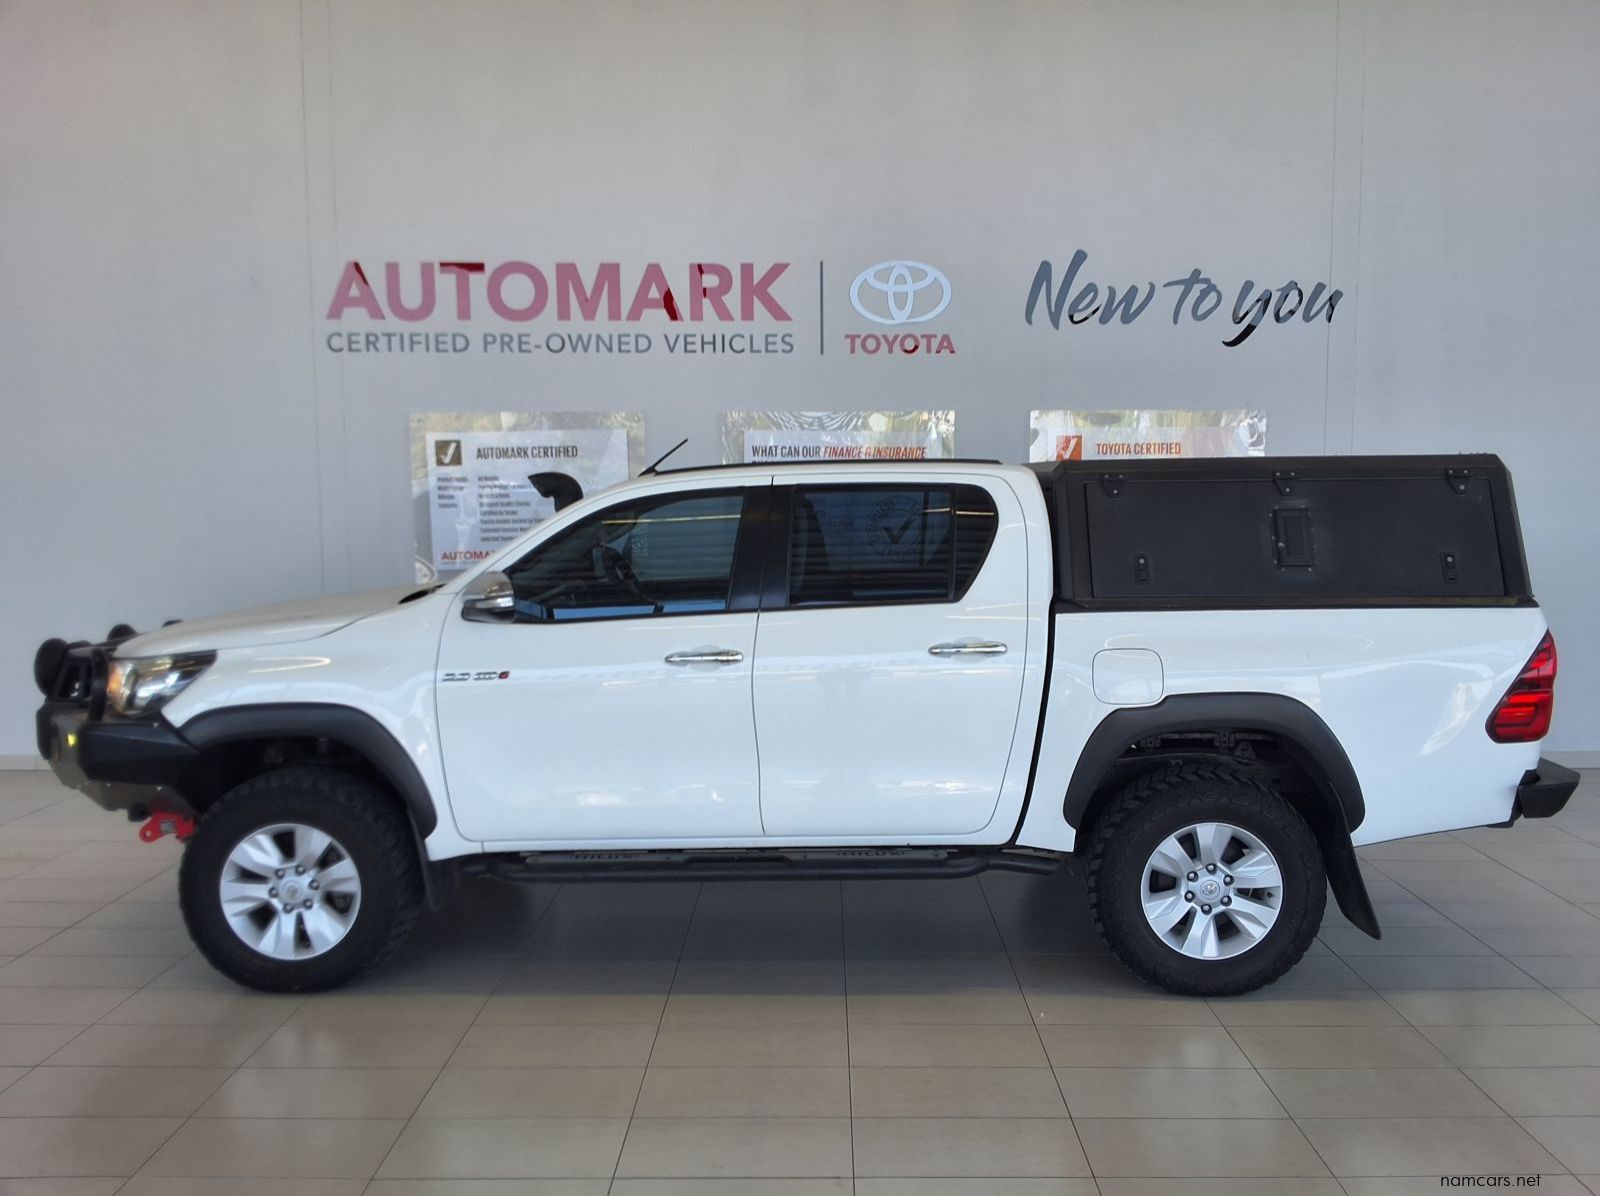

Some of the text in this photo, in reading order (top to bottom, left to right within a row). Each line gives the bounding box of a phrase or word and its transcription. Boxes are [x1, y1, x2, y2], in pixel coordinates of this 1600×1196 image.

[327, 260, 793, 322] AUTOMARK
[1025, 248, 1344, 348] New to you
[327, 332, 794, 355] CERTIFIED PRE-OWNED VEHICLES
[845, 333, 955, 355] TOYOTA
[476, 445, 578, 460] AUTOMARK CERTIFIED
[751, 445, 778, 458] WHAT
[780, 445, 800, 458] CAN
[801, 445, 821, 458] OUR
[823, 446, 863, 459] FINANCE
[873, 446, 927, 459] INSURANCE
[1096, 442, 1181, 455] TOYOTA CERTIFIED
[442, 551, 495, 561] AUTOMA
